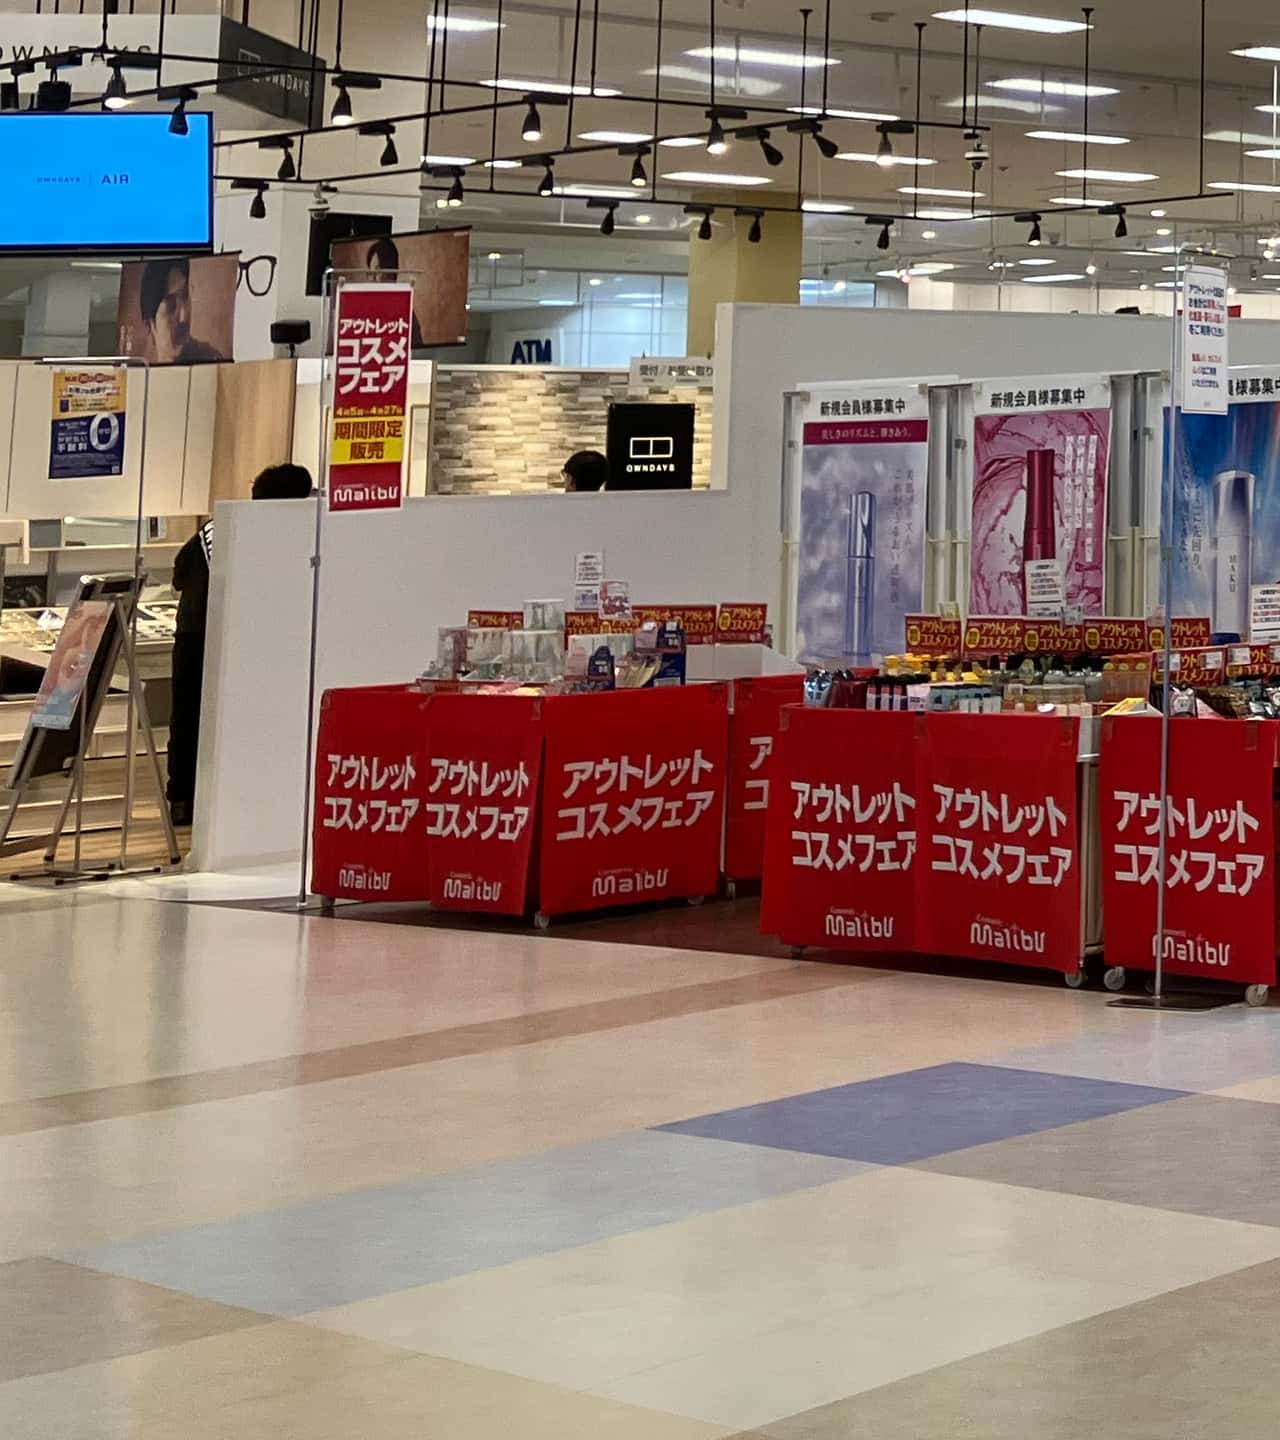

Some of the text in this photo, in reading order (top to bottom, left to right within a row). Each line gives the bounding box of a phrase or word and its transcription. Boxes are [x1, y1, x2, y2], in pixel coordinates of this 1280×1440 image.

[101, 173, 130, 185] AIR
[339, 318, 409, 335] アウトレット
[338, 337, 408, 364] コスメ
[511, 339, 553, 364] ATM
[338, 364, 406, 395] フェア
[820, 399, 906, 417] 新規会員様募集中
[990, 388, 1086, 408] 新規会員様募集中
[626, 464, 675, 472] OWNDAYS
[920, 620, 959, 633] アウトレット
[981, 618, 1021, 634] アウトレット
[1039, 621, 1080, 635] アウトレット
[1101, 620, 1142, 635] アウトレット
[1171, 621, 1207, 635] ウトレット
[920, 634, 960, 647] コスメフェア
[981, 635, 1023, 649] コスメフェア
[1039, 636, 1081, 651] コスメフェア
[1101, 636, 1144, 651] コスメフェア
[1171, 635, 1209, 649] スメフェア
[327, 754, 417, 792] アウトレット
[428, 758, 529, 799] アウトレット
[563, 749, 714, 799] アウトレット
[790, 780, 916, 825] アウトレット
[932, 783, 1068, 838] アウトレット
[322, 796, 420, 833] コスメフェア
[425, 803, 529, 842] コスメフェア
[556, 790, 716, 841] コスメフェア
[1113, 789, 1260, 845] アウトレット
[790, 831, 918, 874] コスメフェア
[931, 834, 1073, 888] コスメフェア
[1113, 843, 1265, 897] コスメフェア
